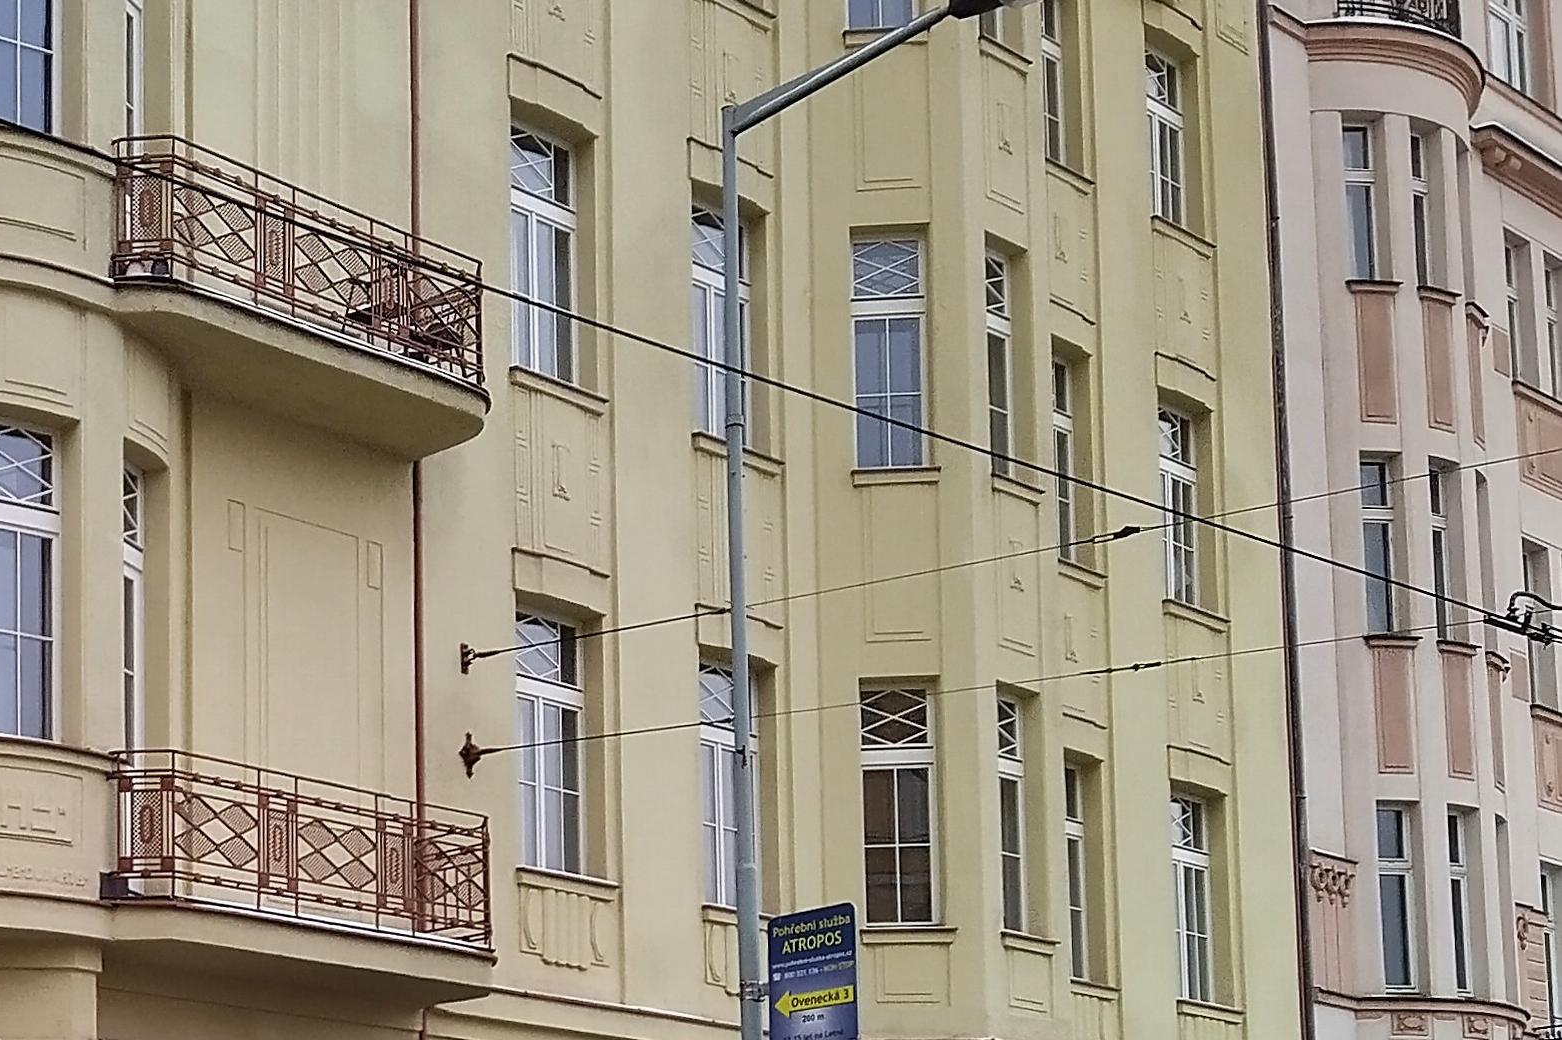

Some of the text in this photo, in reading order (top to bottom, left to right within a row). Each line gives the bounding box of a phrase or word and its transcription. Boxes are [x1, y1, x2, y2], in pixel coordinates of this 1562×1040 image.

[772, 914, 851, 938] Pohřební služba
[781, 930, 842, 955] ATROPOS
[844, 988, 849, 1000] 3
[802, 1013, 815, 1023] 200
